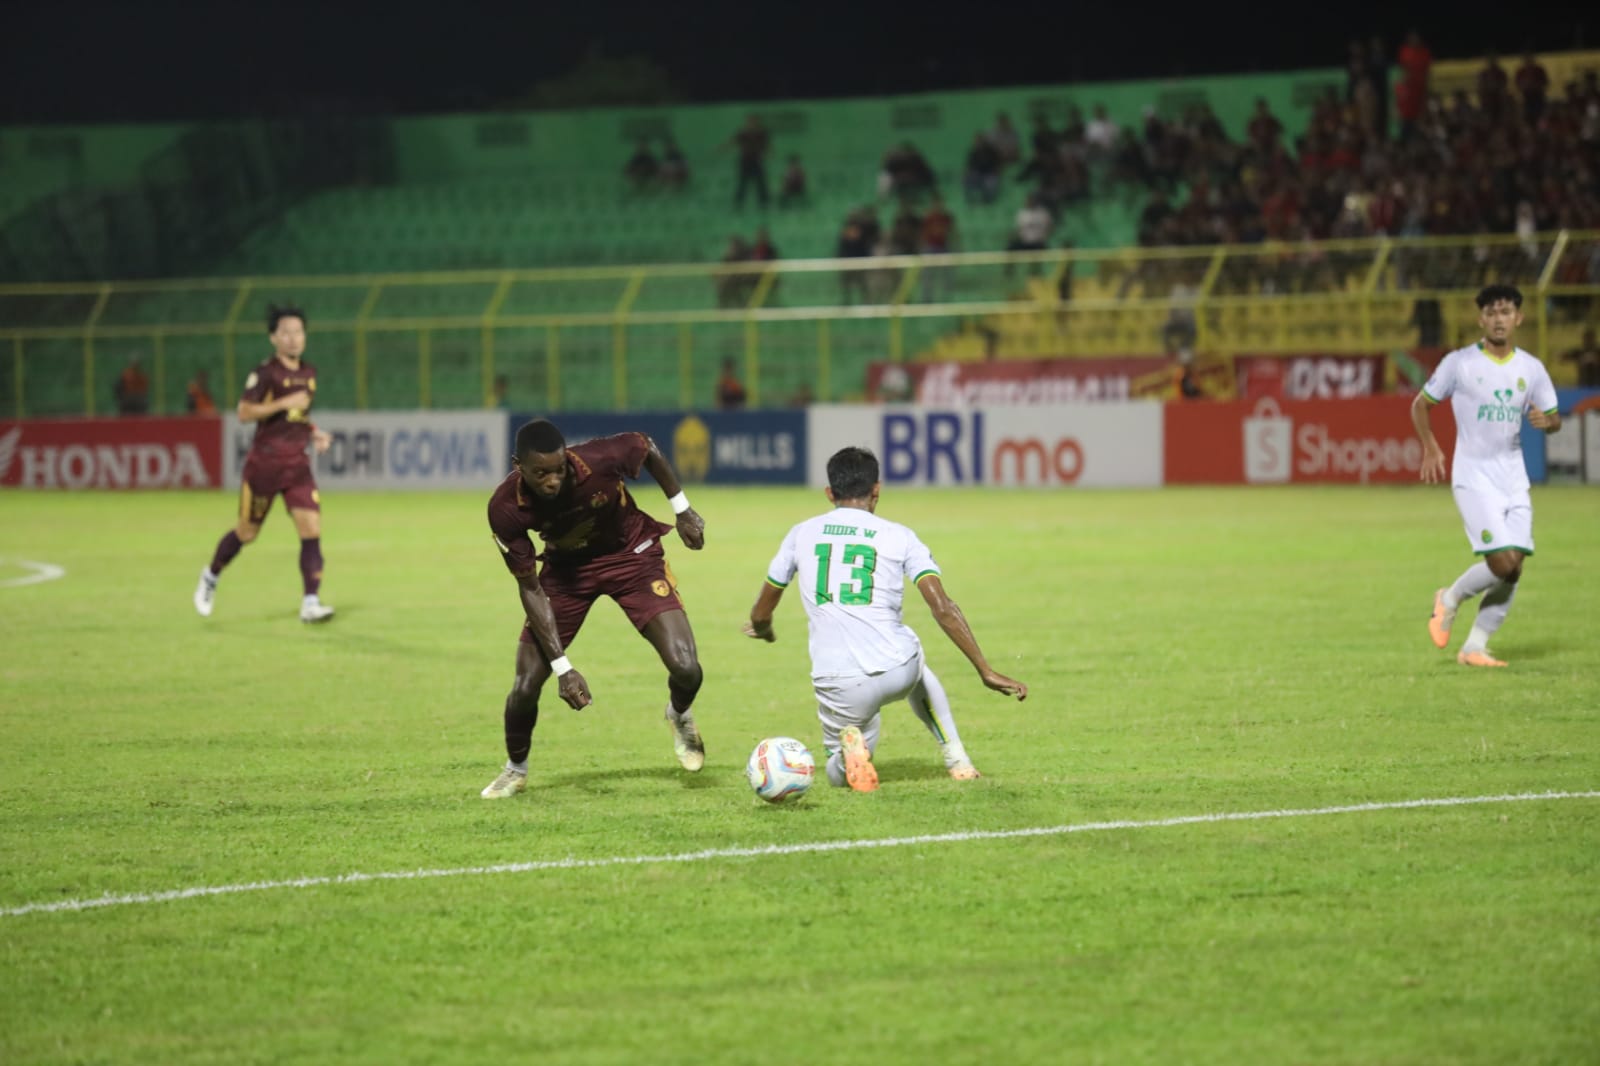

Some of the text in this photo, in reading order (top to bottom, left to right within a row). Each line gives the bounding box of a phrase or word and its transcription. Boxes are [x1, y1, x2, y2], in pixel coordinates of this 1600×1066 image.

[21, 442, 209, 488] HONDA
[389, 430, 494, 476] GOWA
[715, 433, 795, 471] MILLS
[1298, 423, 1422, 485] Shopee
[823, 524, 877, 539] DIDIK W
[814, 543, 877, 606] 13
